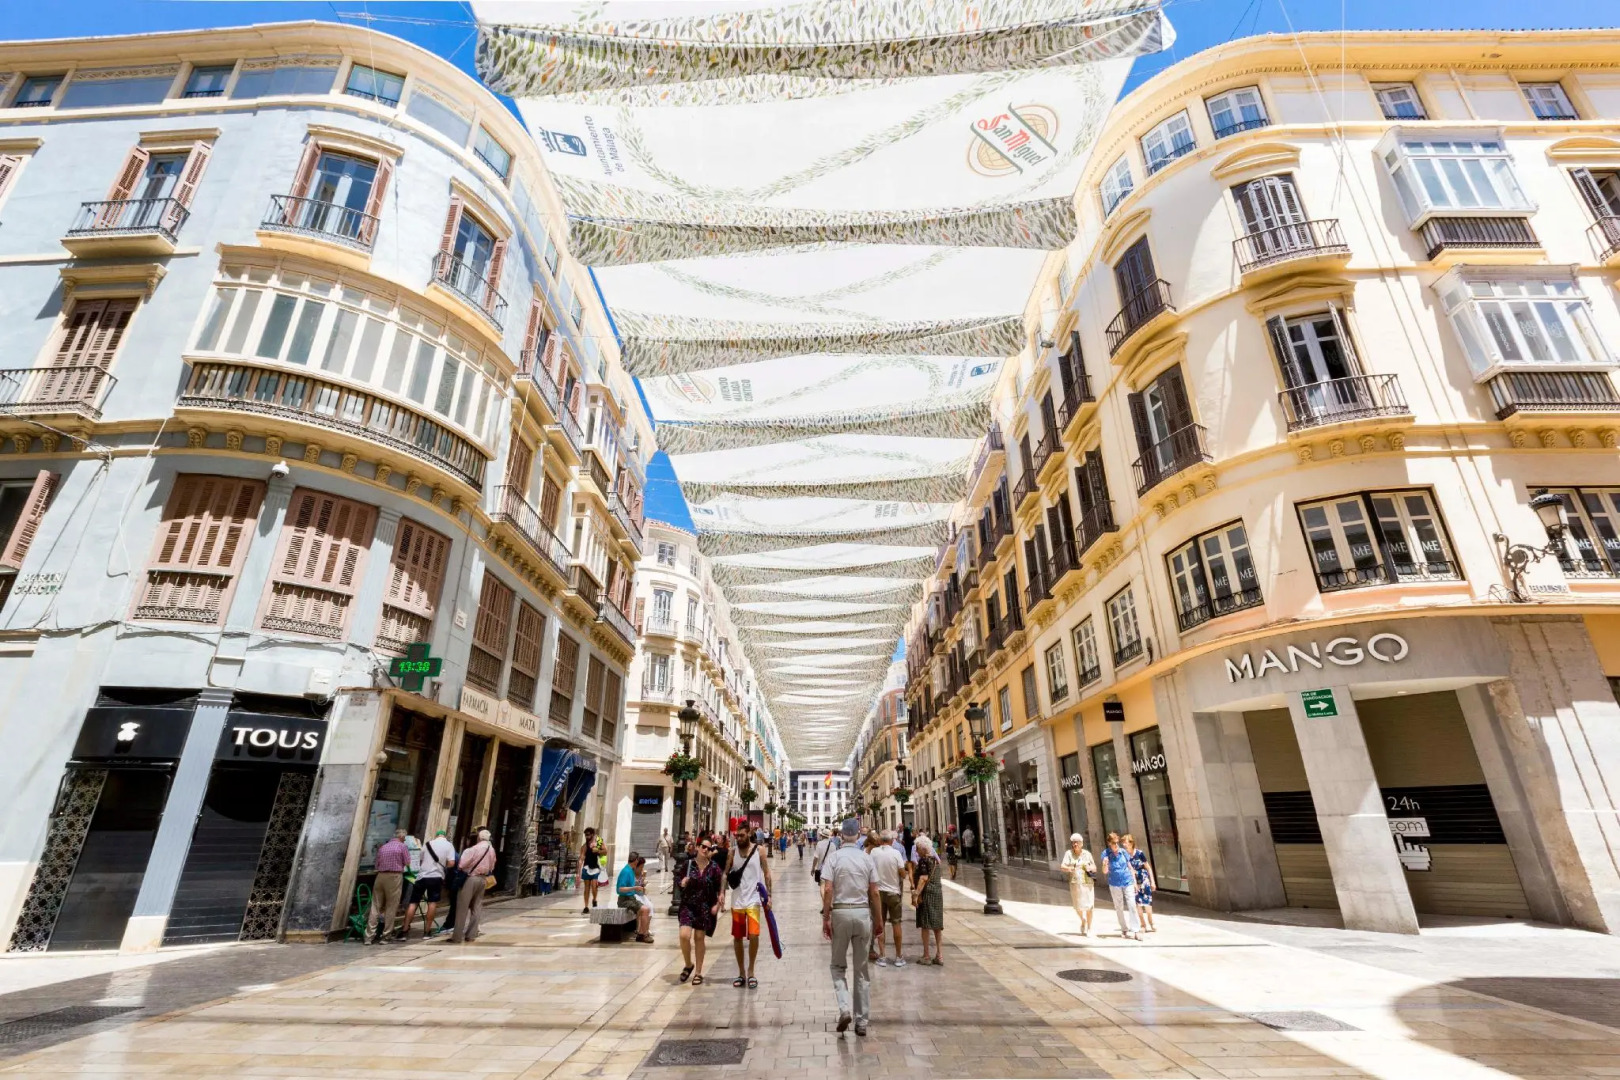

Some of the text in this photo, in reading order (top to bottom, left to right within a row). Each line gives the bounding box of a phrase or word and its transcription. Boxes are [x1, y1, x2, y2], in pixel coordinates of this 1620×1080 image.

[584, 115, 613, 176] Ayuntamiento
[977, 114, 1048, 166] San Miguel
[615, 162, 625, 172] de
[1353, 544, 1372, 557] ME
[1391, 542, 1408, 552] ME
[1421, 540, 1440, 551] ME
[1318, 550, 1336, 561] ME
[1240, 567, 1254, 580] ME
[1215, 576, 1228, 588] ME
[1224, 633, 1409, 683] MANGO
[462, 692, 536, 733] FARMACIA MATA
[232, 727, 319, 749] TOUS
[1132, 753, 1165, 774] MANGO
[1061, 774, 1080, 788] MANGO
[1387, 795, 1421, 811] 24h
